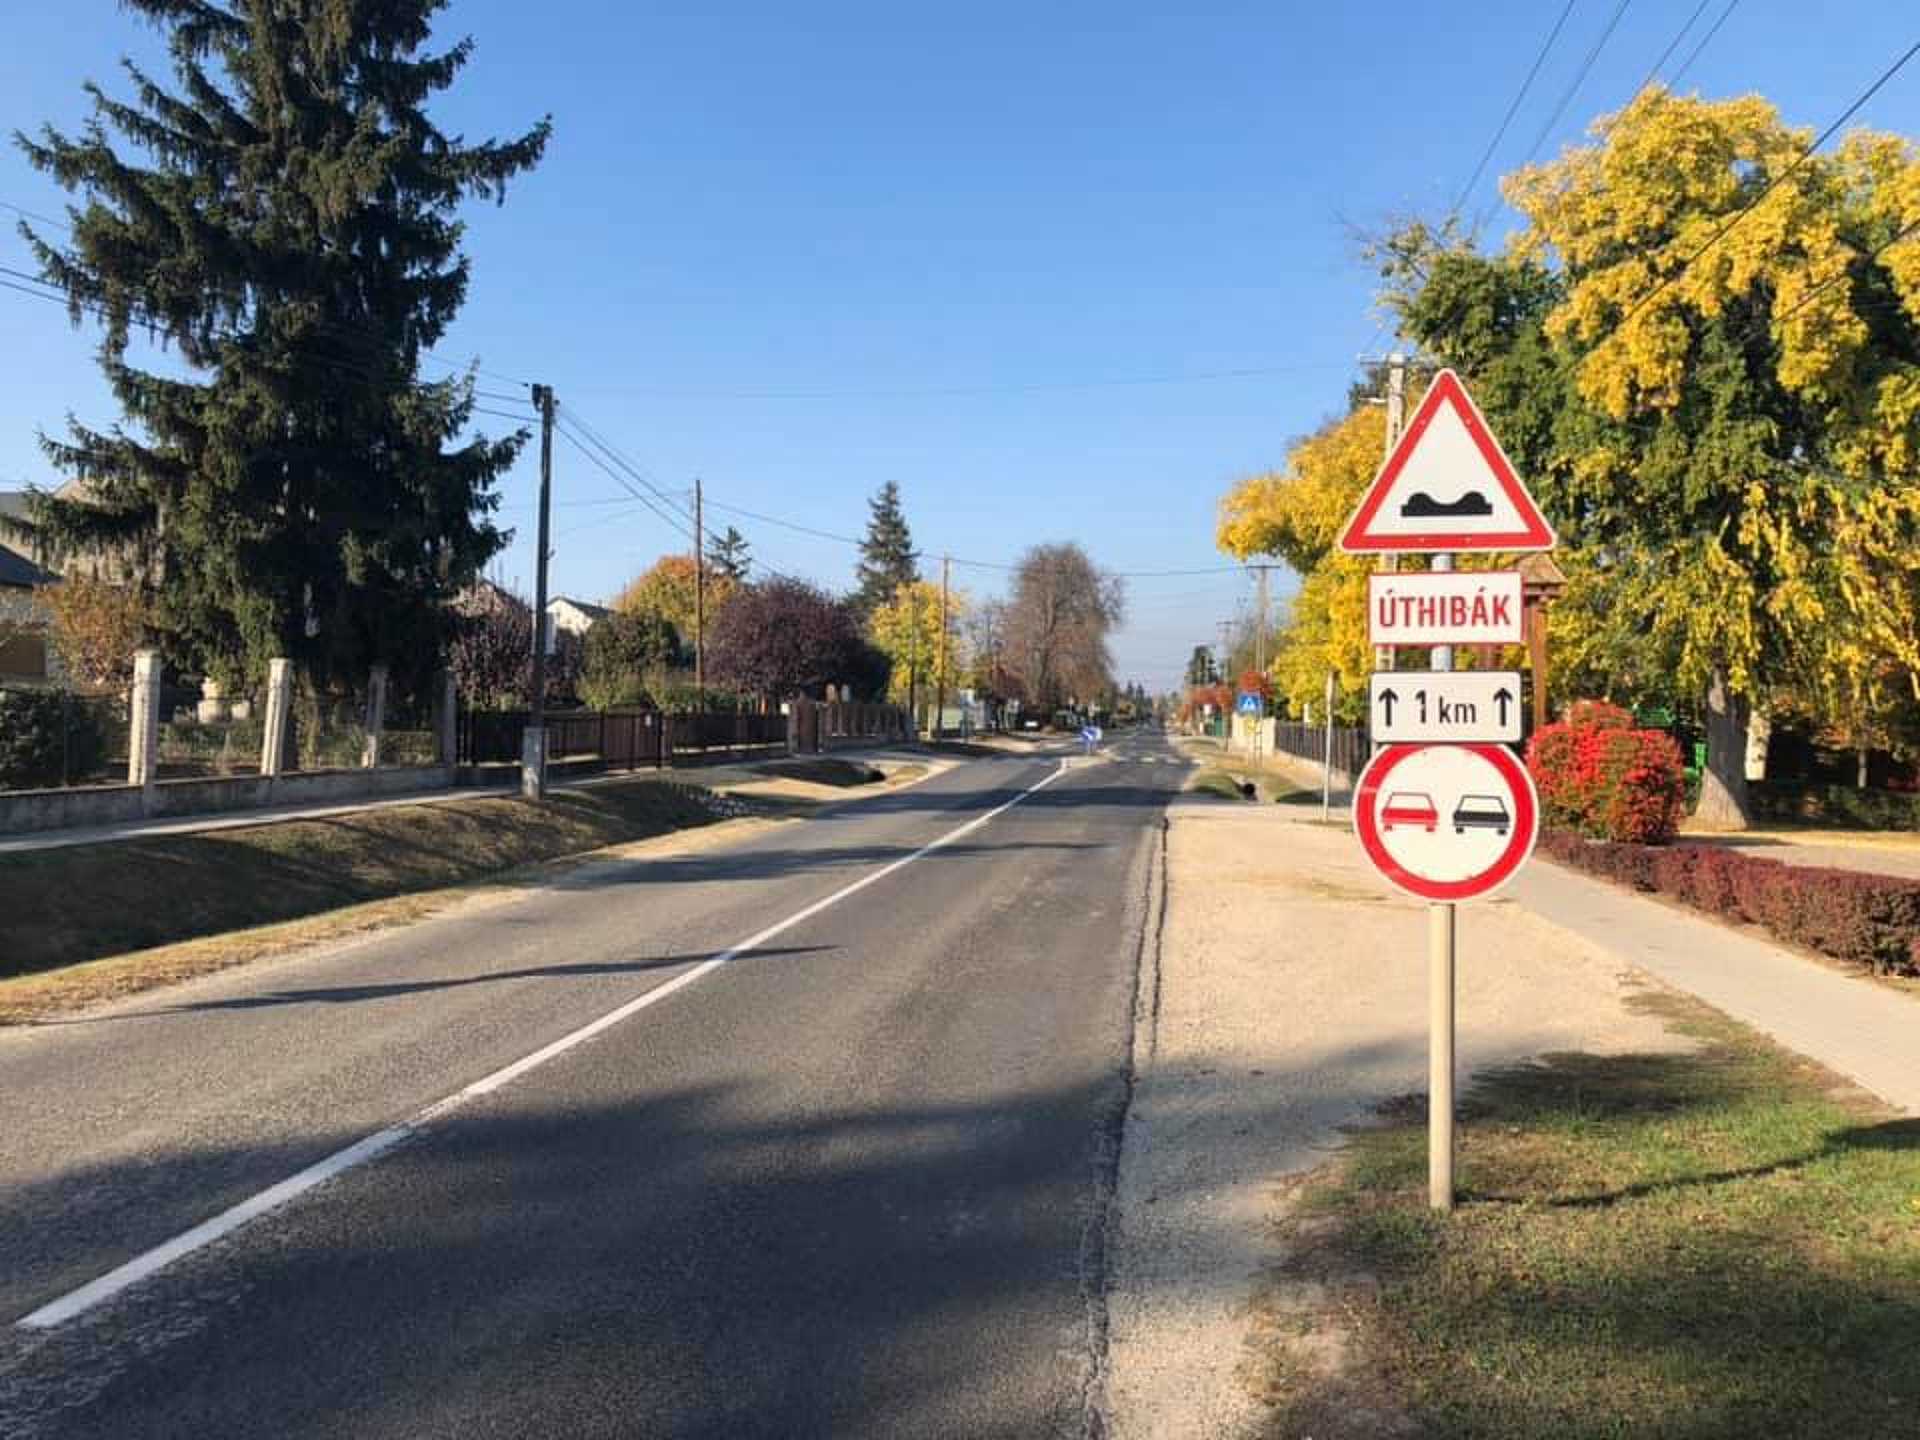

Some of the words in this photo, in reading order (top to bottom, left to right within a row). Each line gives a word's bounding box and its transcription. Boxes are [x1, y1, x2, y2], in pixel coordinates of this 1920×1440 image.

[1379, 587, 1511, 628] ÚTHIBÁK
[1415, 690, 1427, 724] 1
[1438, 696, 1477, 724] km
